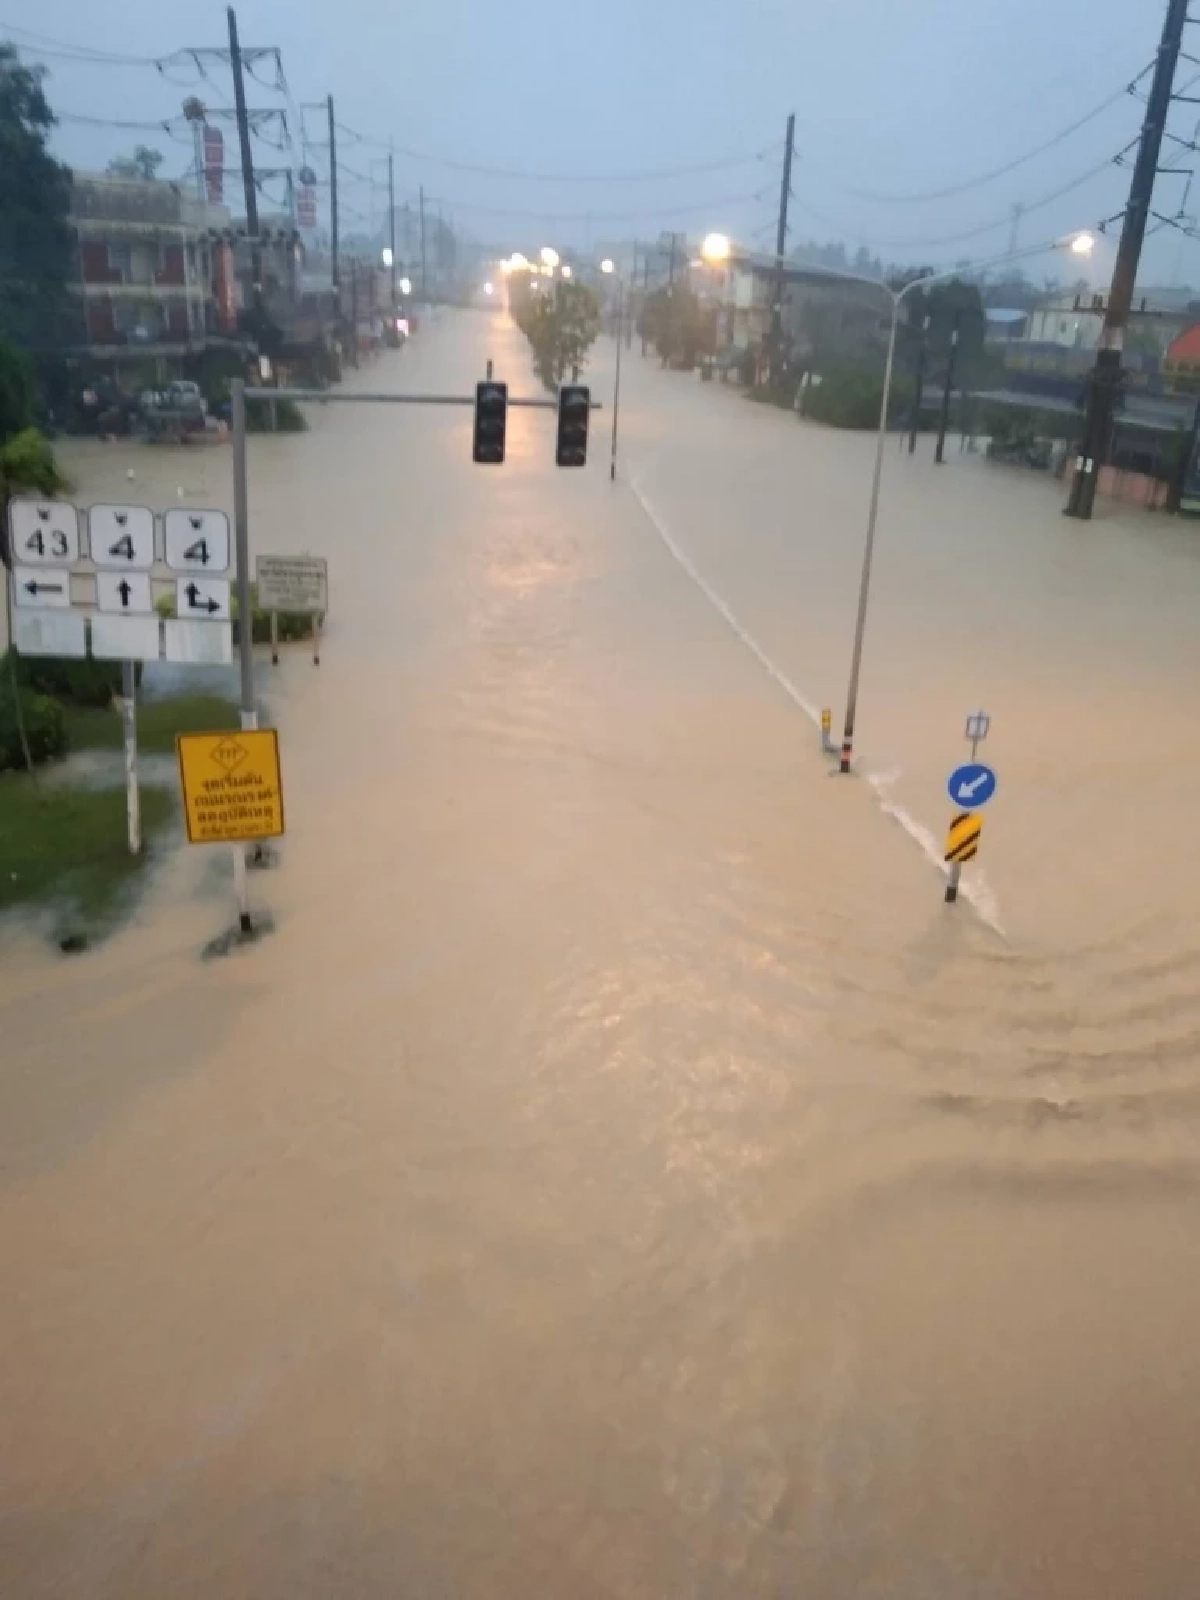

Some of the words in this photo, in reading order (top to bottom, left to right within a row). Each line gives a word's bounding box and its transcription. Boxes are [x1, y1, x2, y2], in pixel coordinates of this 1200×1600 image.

[25, 528, 68, 556] 43
[108, 533, 135, 560] 4
[183, 537, 209, 566] 4
